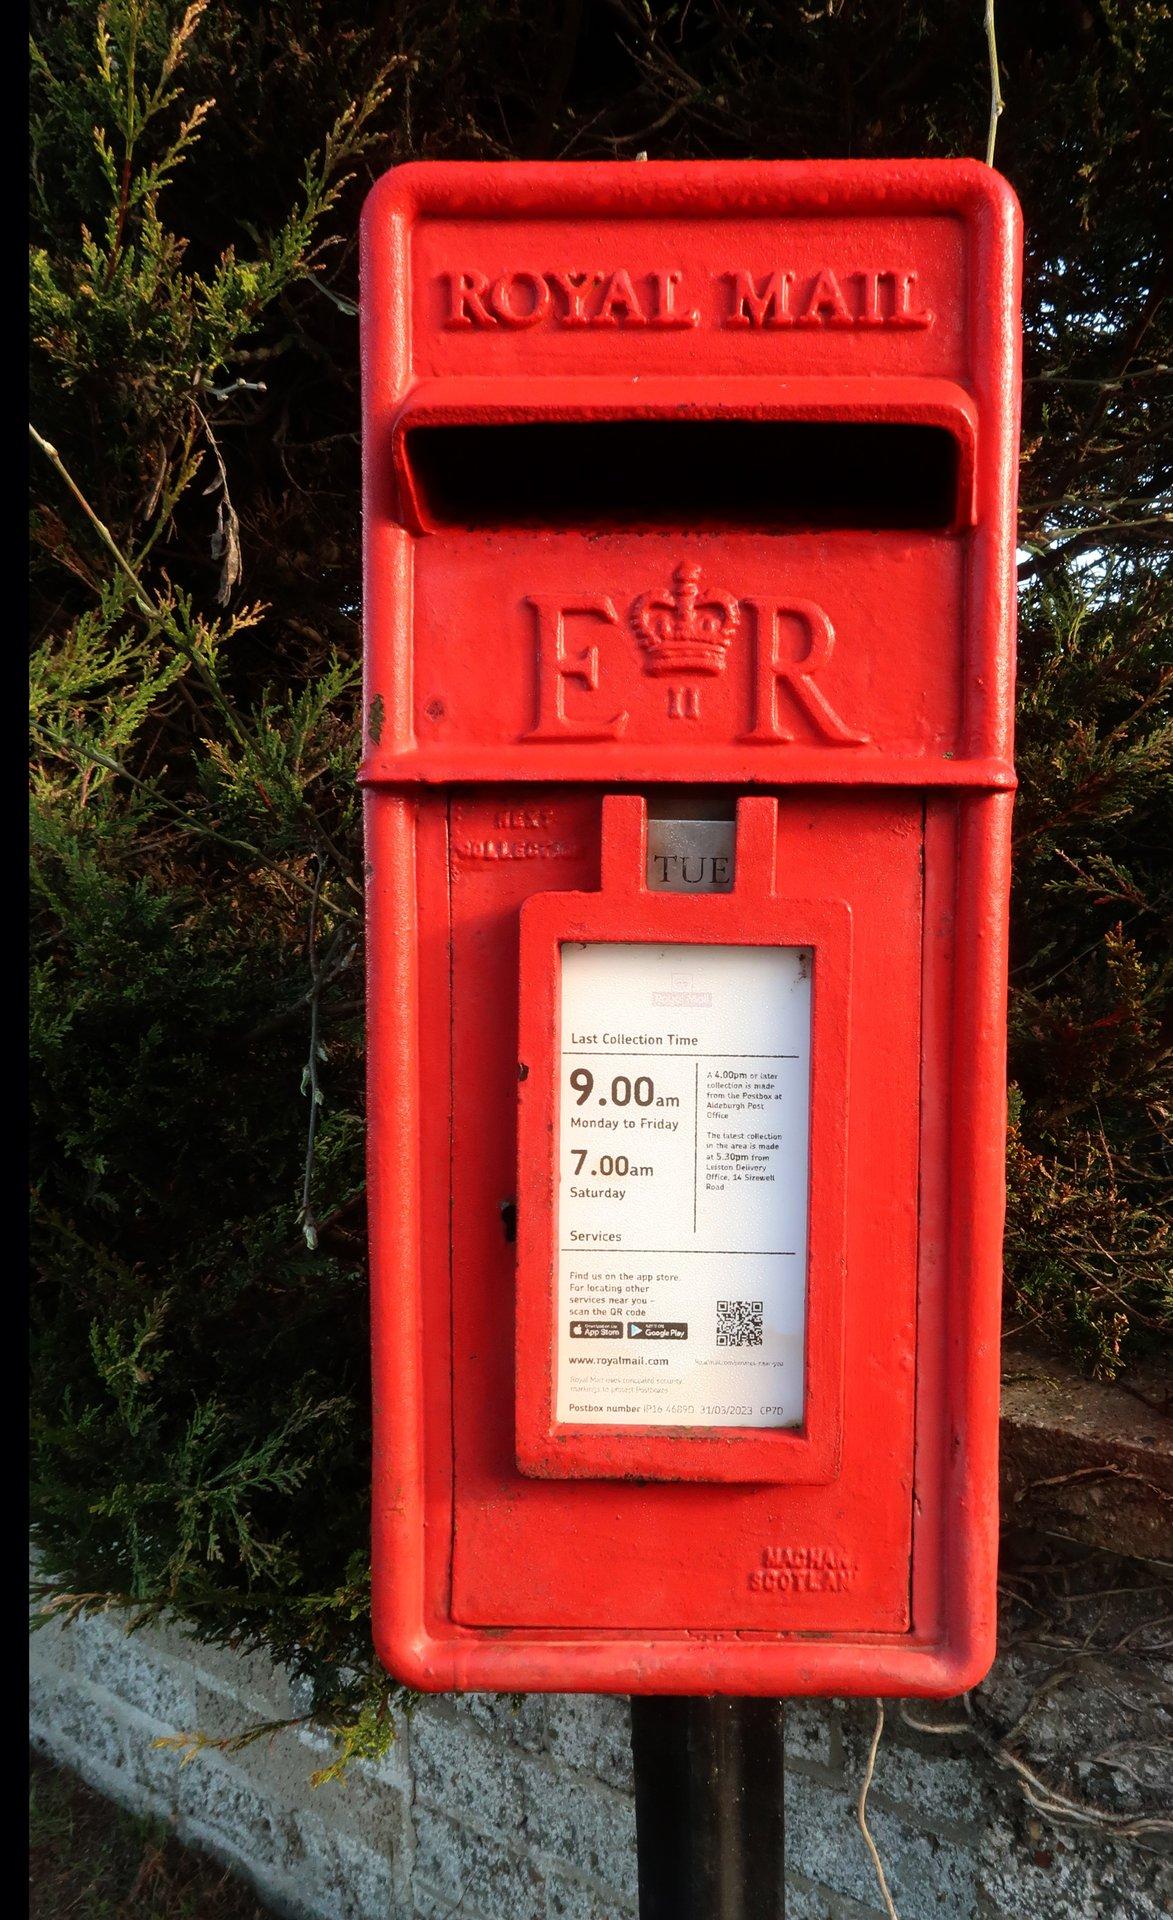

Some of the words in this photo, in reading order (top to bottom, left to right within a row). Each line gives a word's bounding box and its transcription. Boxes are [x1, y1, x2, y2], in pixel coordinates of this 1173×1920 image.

[440, 269, 699, 331] ROYAL
[717, 269, 936, 331] MAIL
[519, 594, 630, 745] E
[735, 595, 872, 746] R
[654, 854, 731, 885] TUE
[571, 1033, 598, 1045] Last
[603, 1034, 663, 1045] Collection
[667, 1034, 698, 1046] Time
[715, 1071, 747, 1080] 4.00pm
[707, 1102, 745, 1110] Aldeburgh
[571, 1117, 619, 1130] Monday
[623, 1118, 635, 1128] to
[640, 1118, 679, 1131] Friday
[716, 1153, 748, 1161] 5.30pm
[570, 1149, 654, 1177] 7.00am
[736, 1164, 766, 1172] Delivery
[570, 1187, 626, 1200] Saturday
[570, 1231, 622, 1242] Services
[637, 1274, 653, 1282] app
[587, 1284, 622, 1293] locating
[610, 1308, 622, 1316] QR
[645, 1329, 669, 1337] Google
[671, 1329, 685, 1338] Play
[569, 1356, 669, 1366] www.royalmail.com
[569, 1404, 603, 1412] Postbox
[607, 1405, 640, 1413] number
[643, 1405, 662, 1413] IP16
[701, 1406, 752, 1415] 31/03/2023
